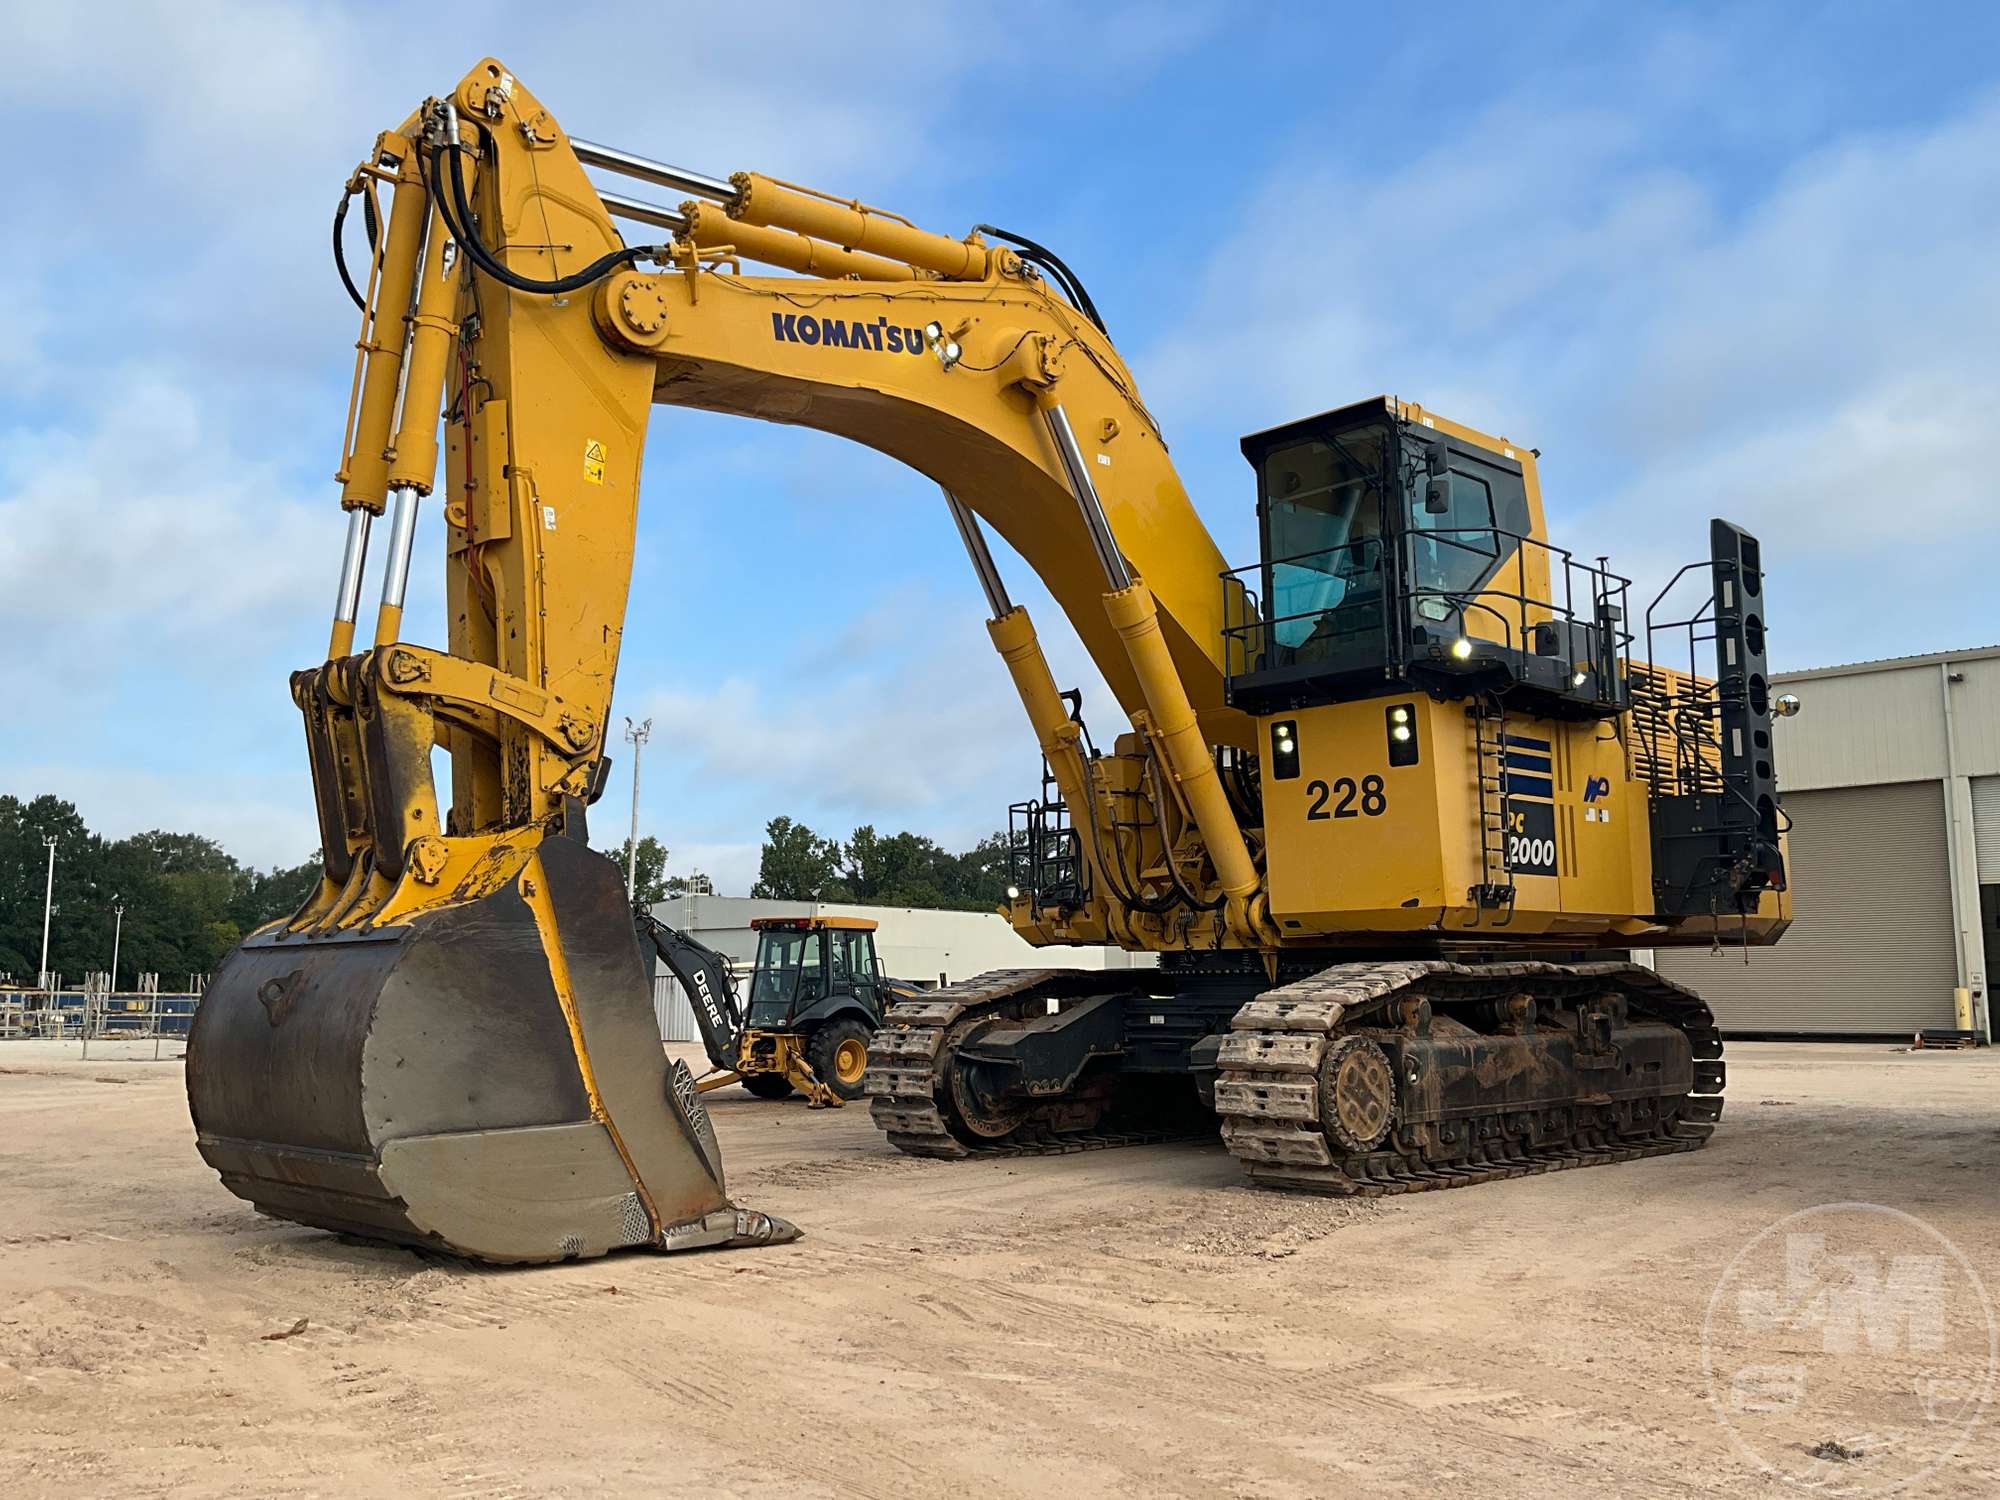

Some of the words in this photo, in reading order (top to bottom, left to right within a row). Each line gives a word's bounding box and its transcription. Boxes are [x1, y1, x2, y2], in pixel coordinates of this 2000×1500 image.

[772, 312, 924, 355] KOMATSU
[1306, 774, 1387, 820] 228
[1506, 836, 1555, 866] 2000
[693, 969, 724, 1028] DEERE
